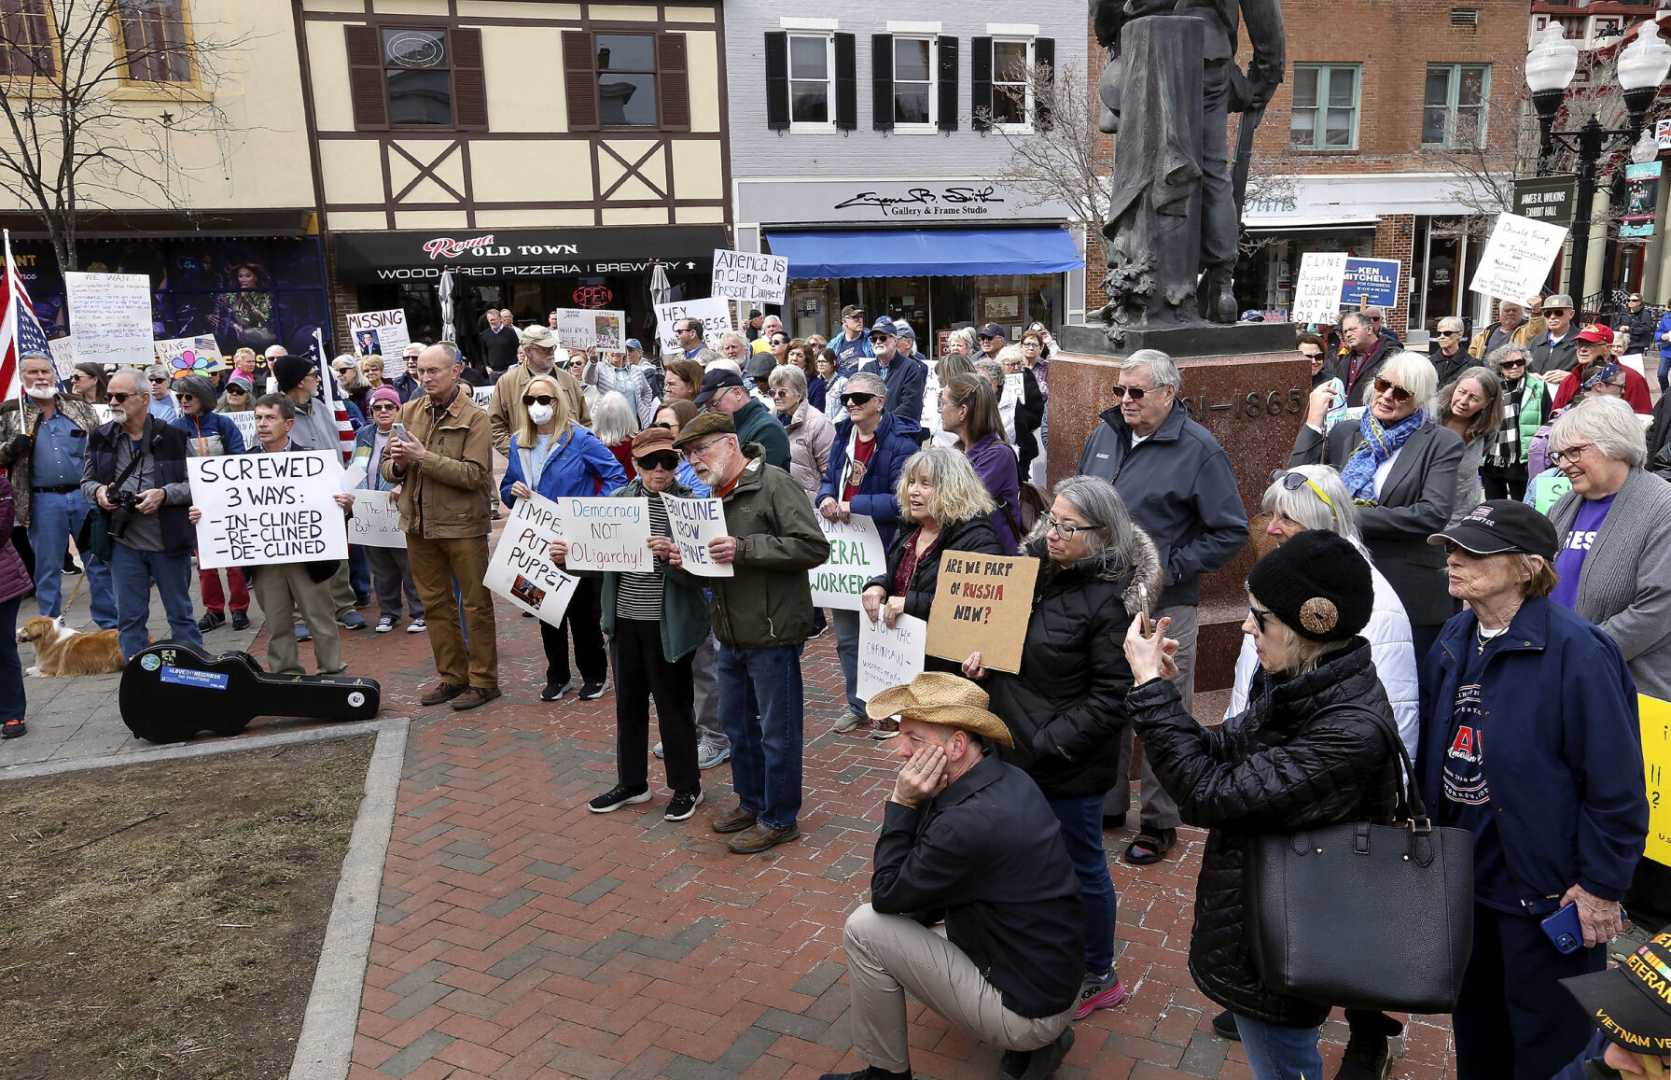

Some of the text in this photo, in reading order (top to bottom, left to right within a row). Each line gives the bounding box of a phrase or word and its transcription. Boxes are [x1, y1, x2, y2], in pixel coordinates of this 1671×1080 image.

[1543, 191, 1566, 203] WILKINS
[891, 206, 921, 216] Gallery
[934, 207, 960, 215] Frame
[962, 204, 988, 214] Studio
[1525, 205, 1557, 218] EXHIBIT HALL
[423, 234, 495, 260] Roma
[471, 243, 579, 257] OLD TOWN
[502, 263, 582, 276] PIZZERIA
[596, 260, 681, 273] BREWRY
[1357, 266, 1380, 275] KEN
[348, 310, 403, 329] MISSING
[661, 306, 688, 322] HEY
[1296, 311, 1314, 322] OR
[200, 456, 324, 483] SCREWED
[225, 485, 305, 508] 3 WAYS:
[681, 500, 719, 521] CLINE
[591, 522, 623, 540] NOT
[519, 528, 552, 556] PUT
[507, 546, 571, 593] PUPPET
[945, 558, 1014, 577] ARE WE PART
[950, 582, 1004, 601] OF RUSSIA
[953, 604, 992, 625] NOW?
[1595, 1007, 1651, 1049] VIETNAM
